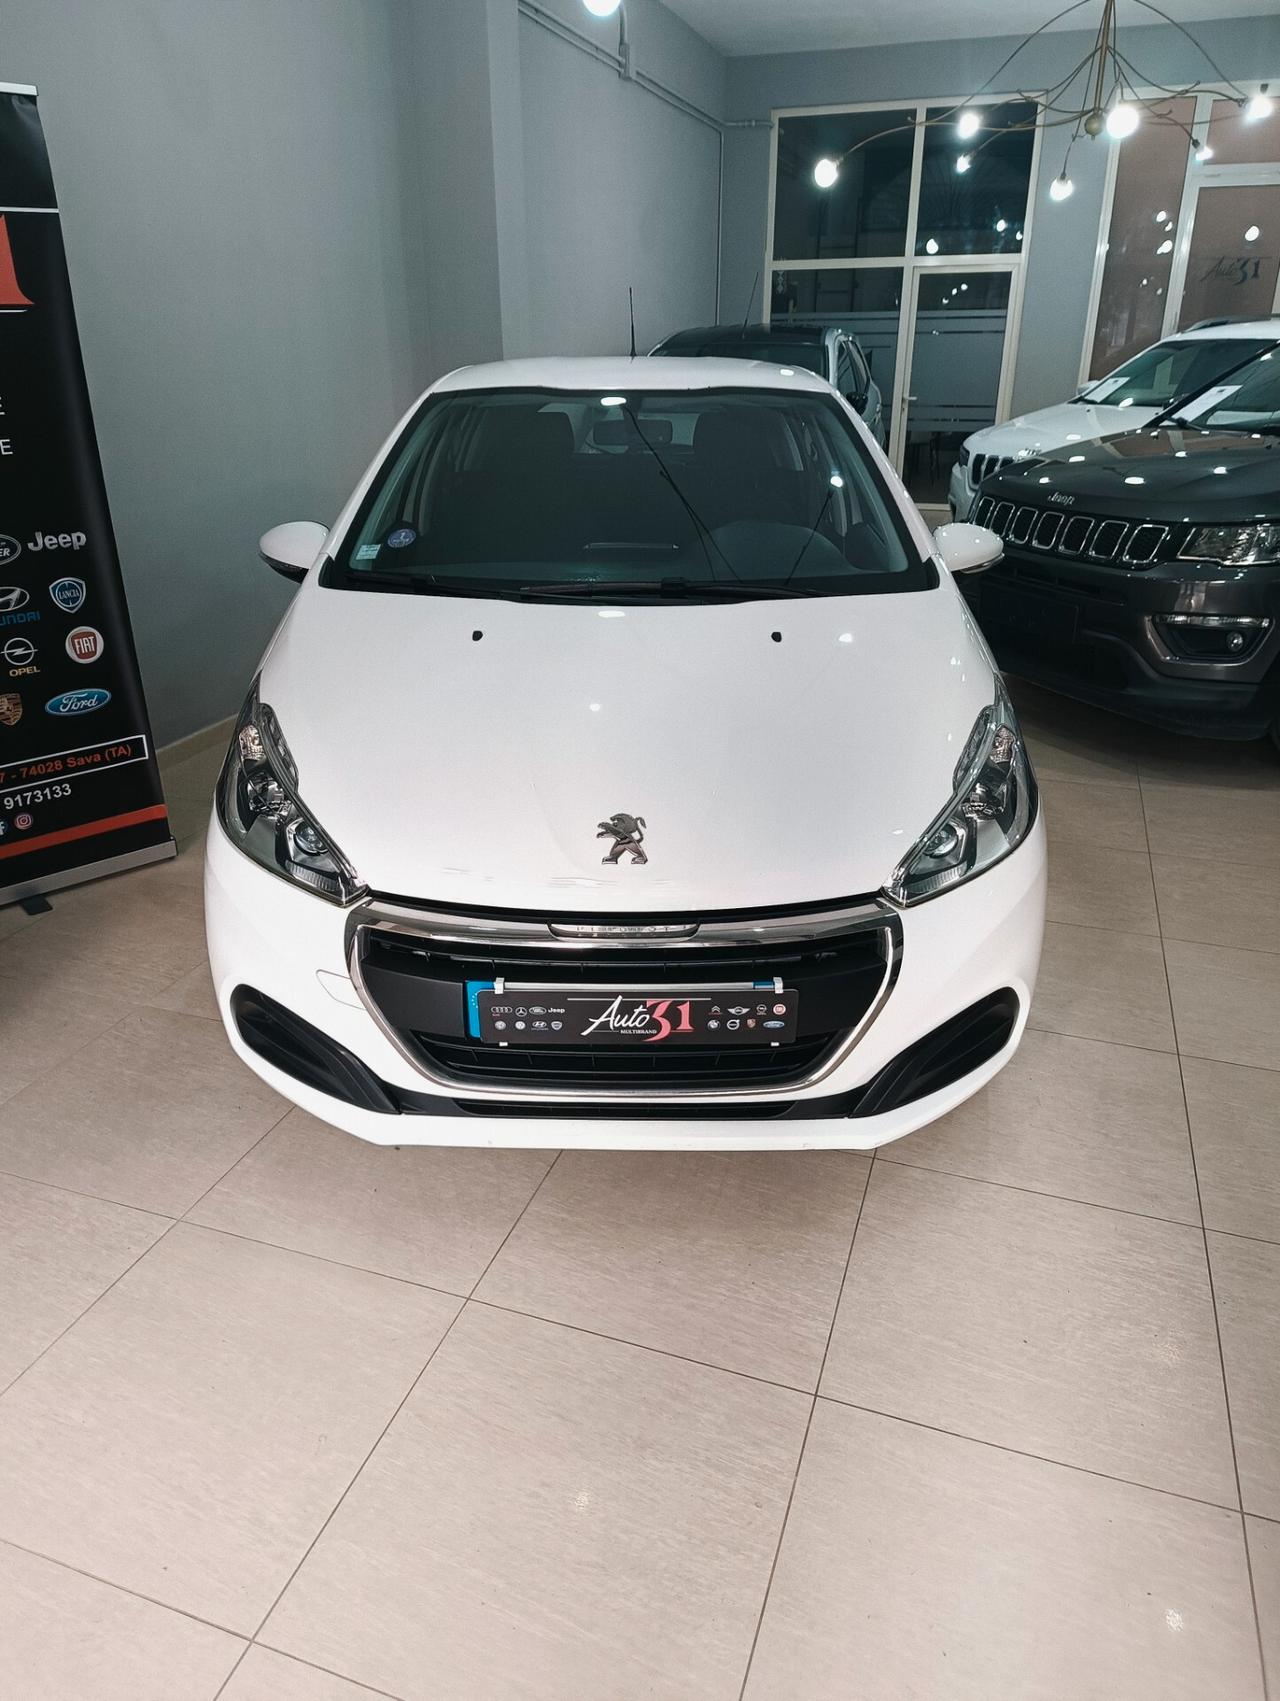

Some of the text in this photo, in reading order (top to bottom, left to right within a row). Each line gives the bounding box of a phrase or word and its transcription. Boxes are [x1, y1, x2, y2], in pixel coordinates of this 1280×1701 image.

[27, 531, 87, 550] Jeep
[58, 587, 80, 599] LANCIA
[74, 635, 96, 655] FIAT
[9, 666, 41, 677] OPEL
[59, 693, 98, 713] Ford
[19, 760, 63, 779] 74028
[66, 752, 101, 769] Sava
[104, 744, 132, 762] (TA)
[4, 783, 72, 810] 9173133
[580, 994, 694, 1042] Auto 31
